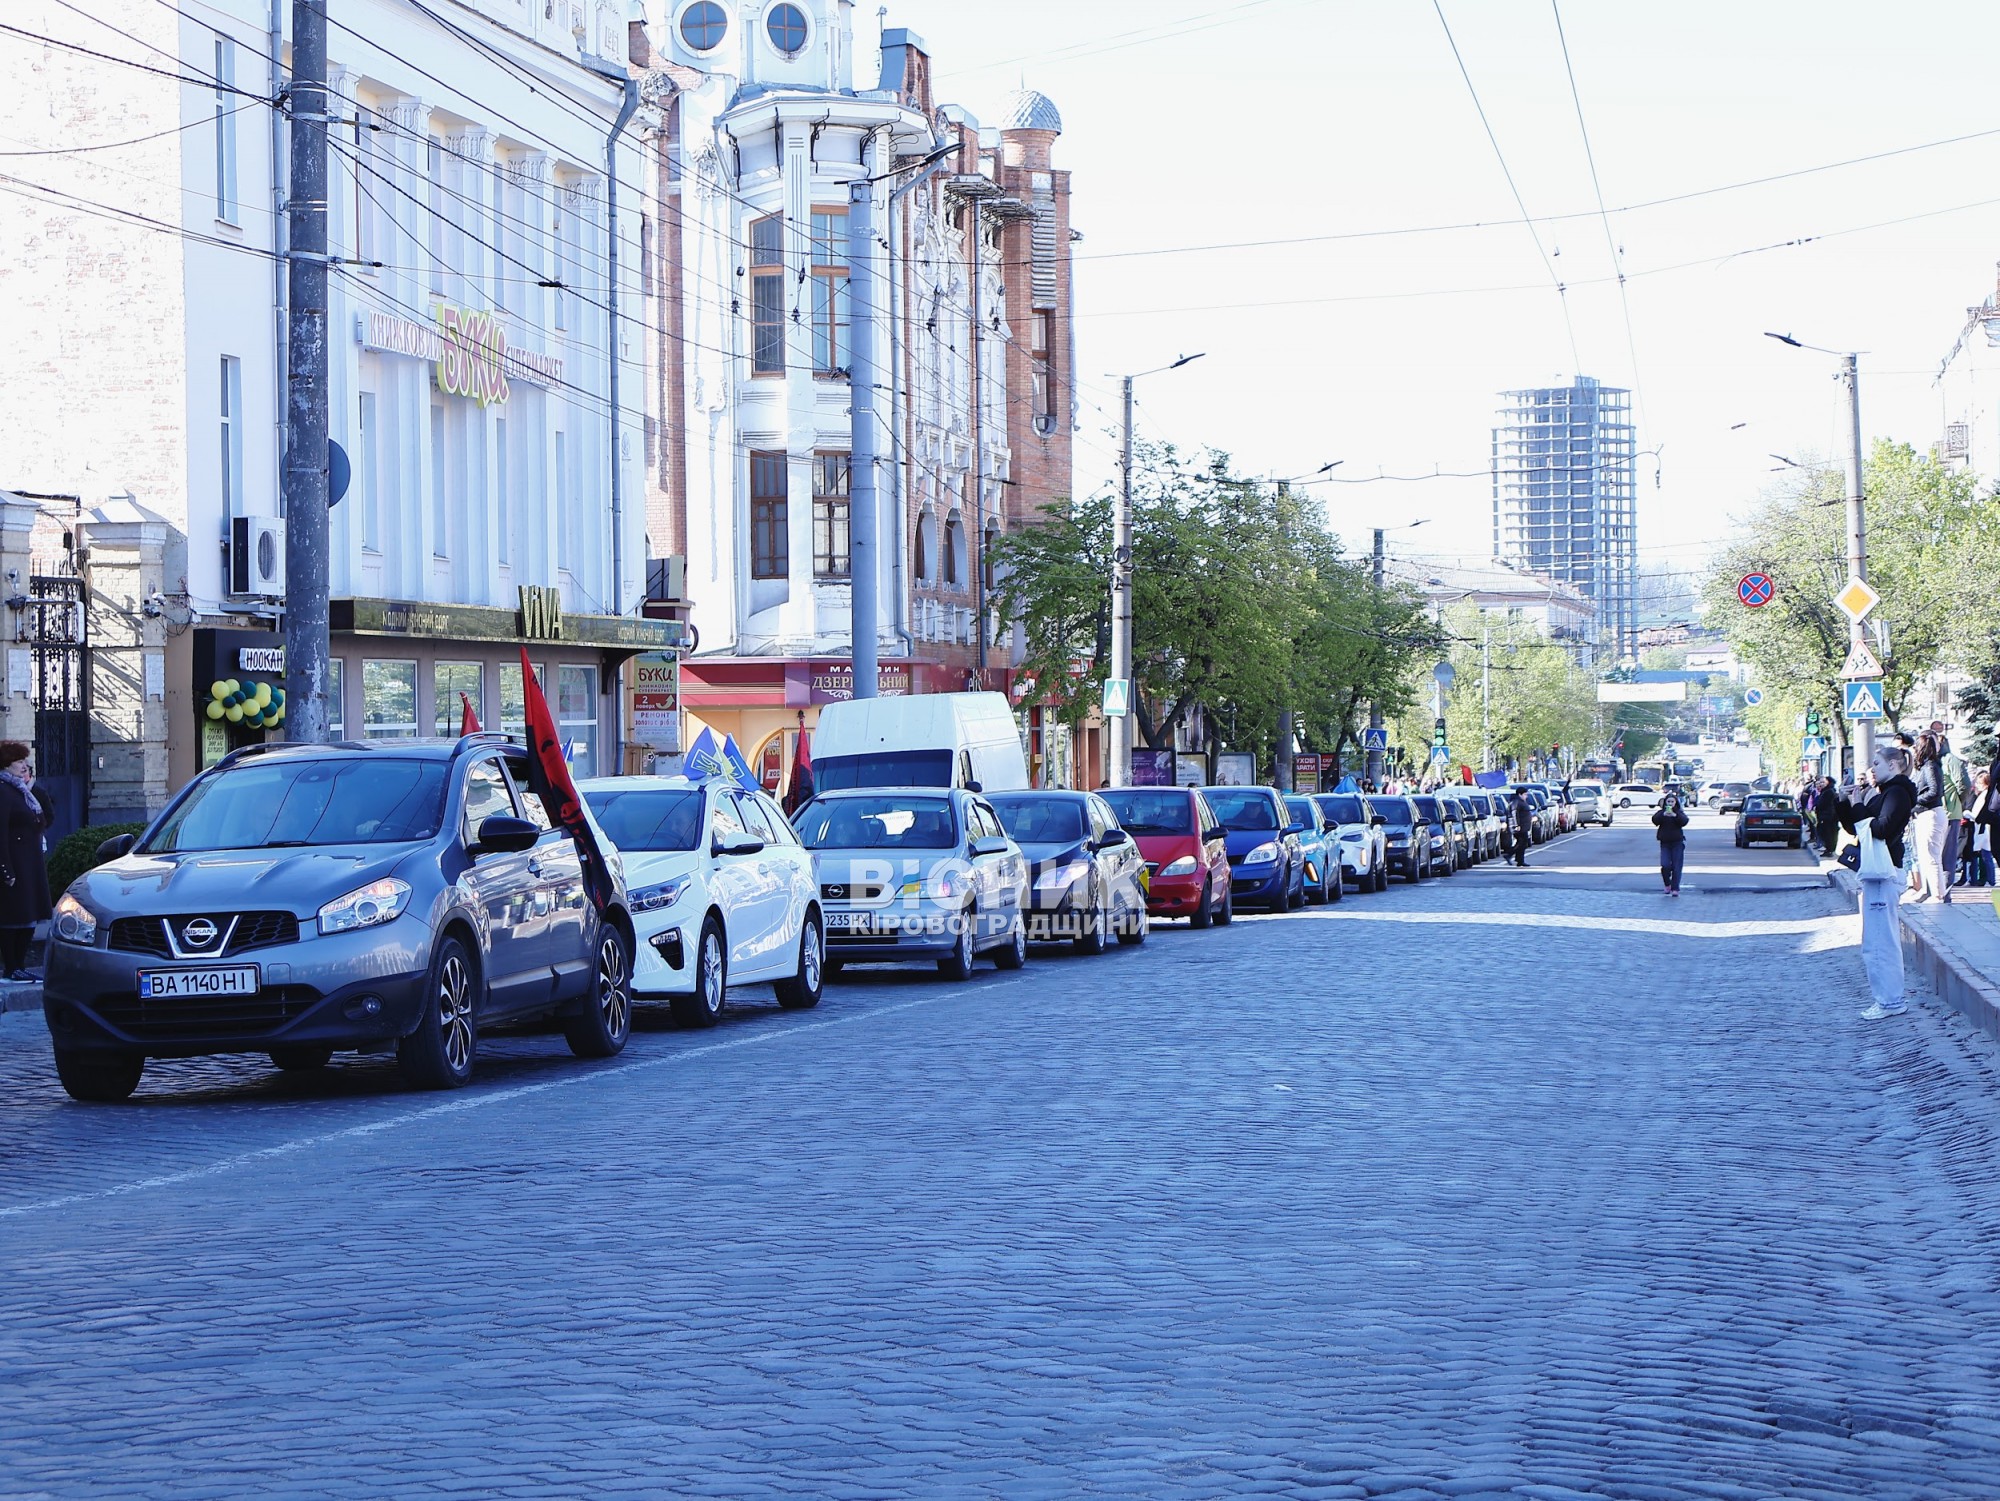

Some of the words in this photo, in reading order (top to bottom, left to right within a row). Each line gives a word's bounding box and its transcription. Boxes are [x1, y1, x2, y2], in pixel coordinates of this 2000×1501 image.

[369, 309, 441, 362] КНИЖКОВИЙ
[442, 304, 510, 408] БУКИ
[505, 346, 564, 389] СУПЕРМАРКЕТ
[245, 648, 284, 672] HOOKAH
[638, 667, 674, 682] БУКИ
[812, 673, 909, 691] ДЗЕРЬНИЙ
[642, 695, 649, 704] 2
[152, 975, 178, 995] BA
[181, 973, 220, 993] 1140
[222, 971, 246, 991] HI
